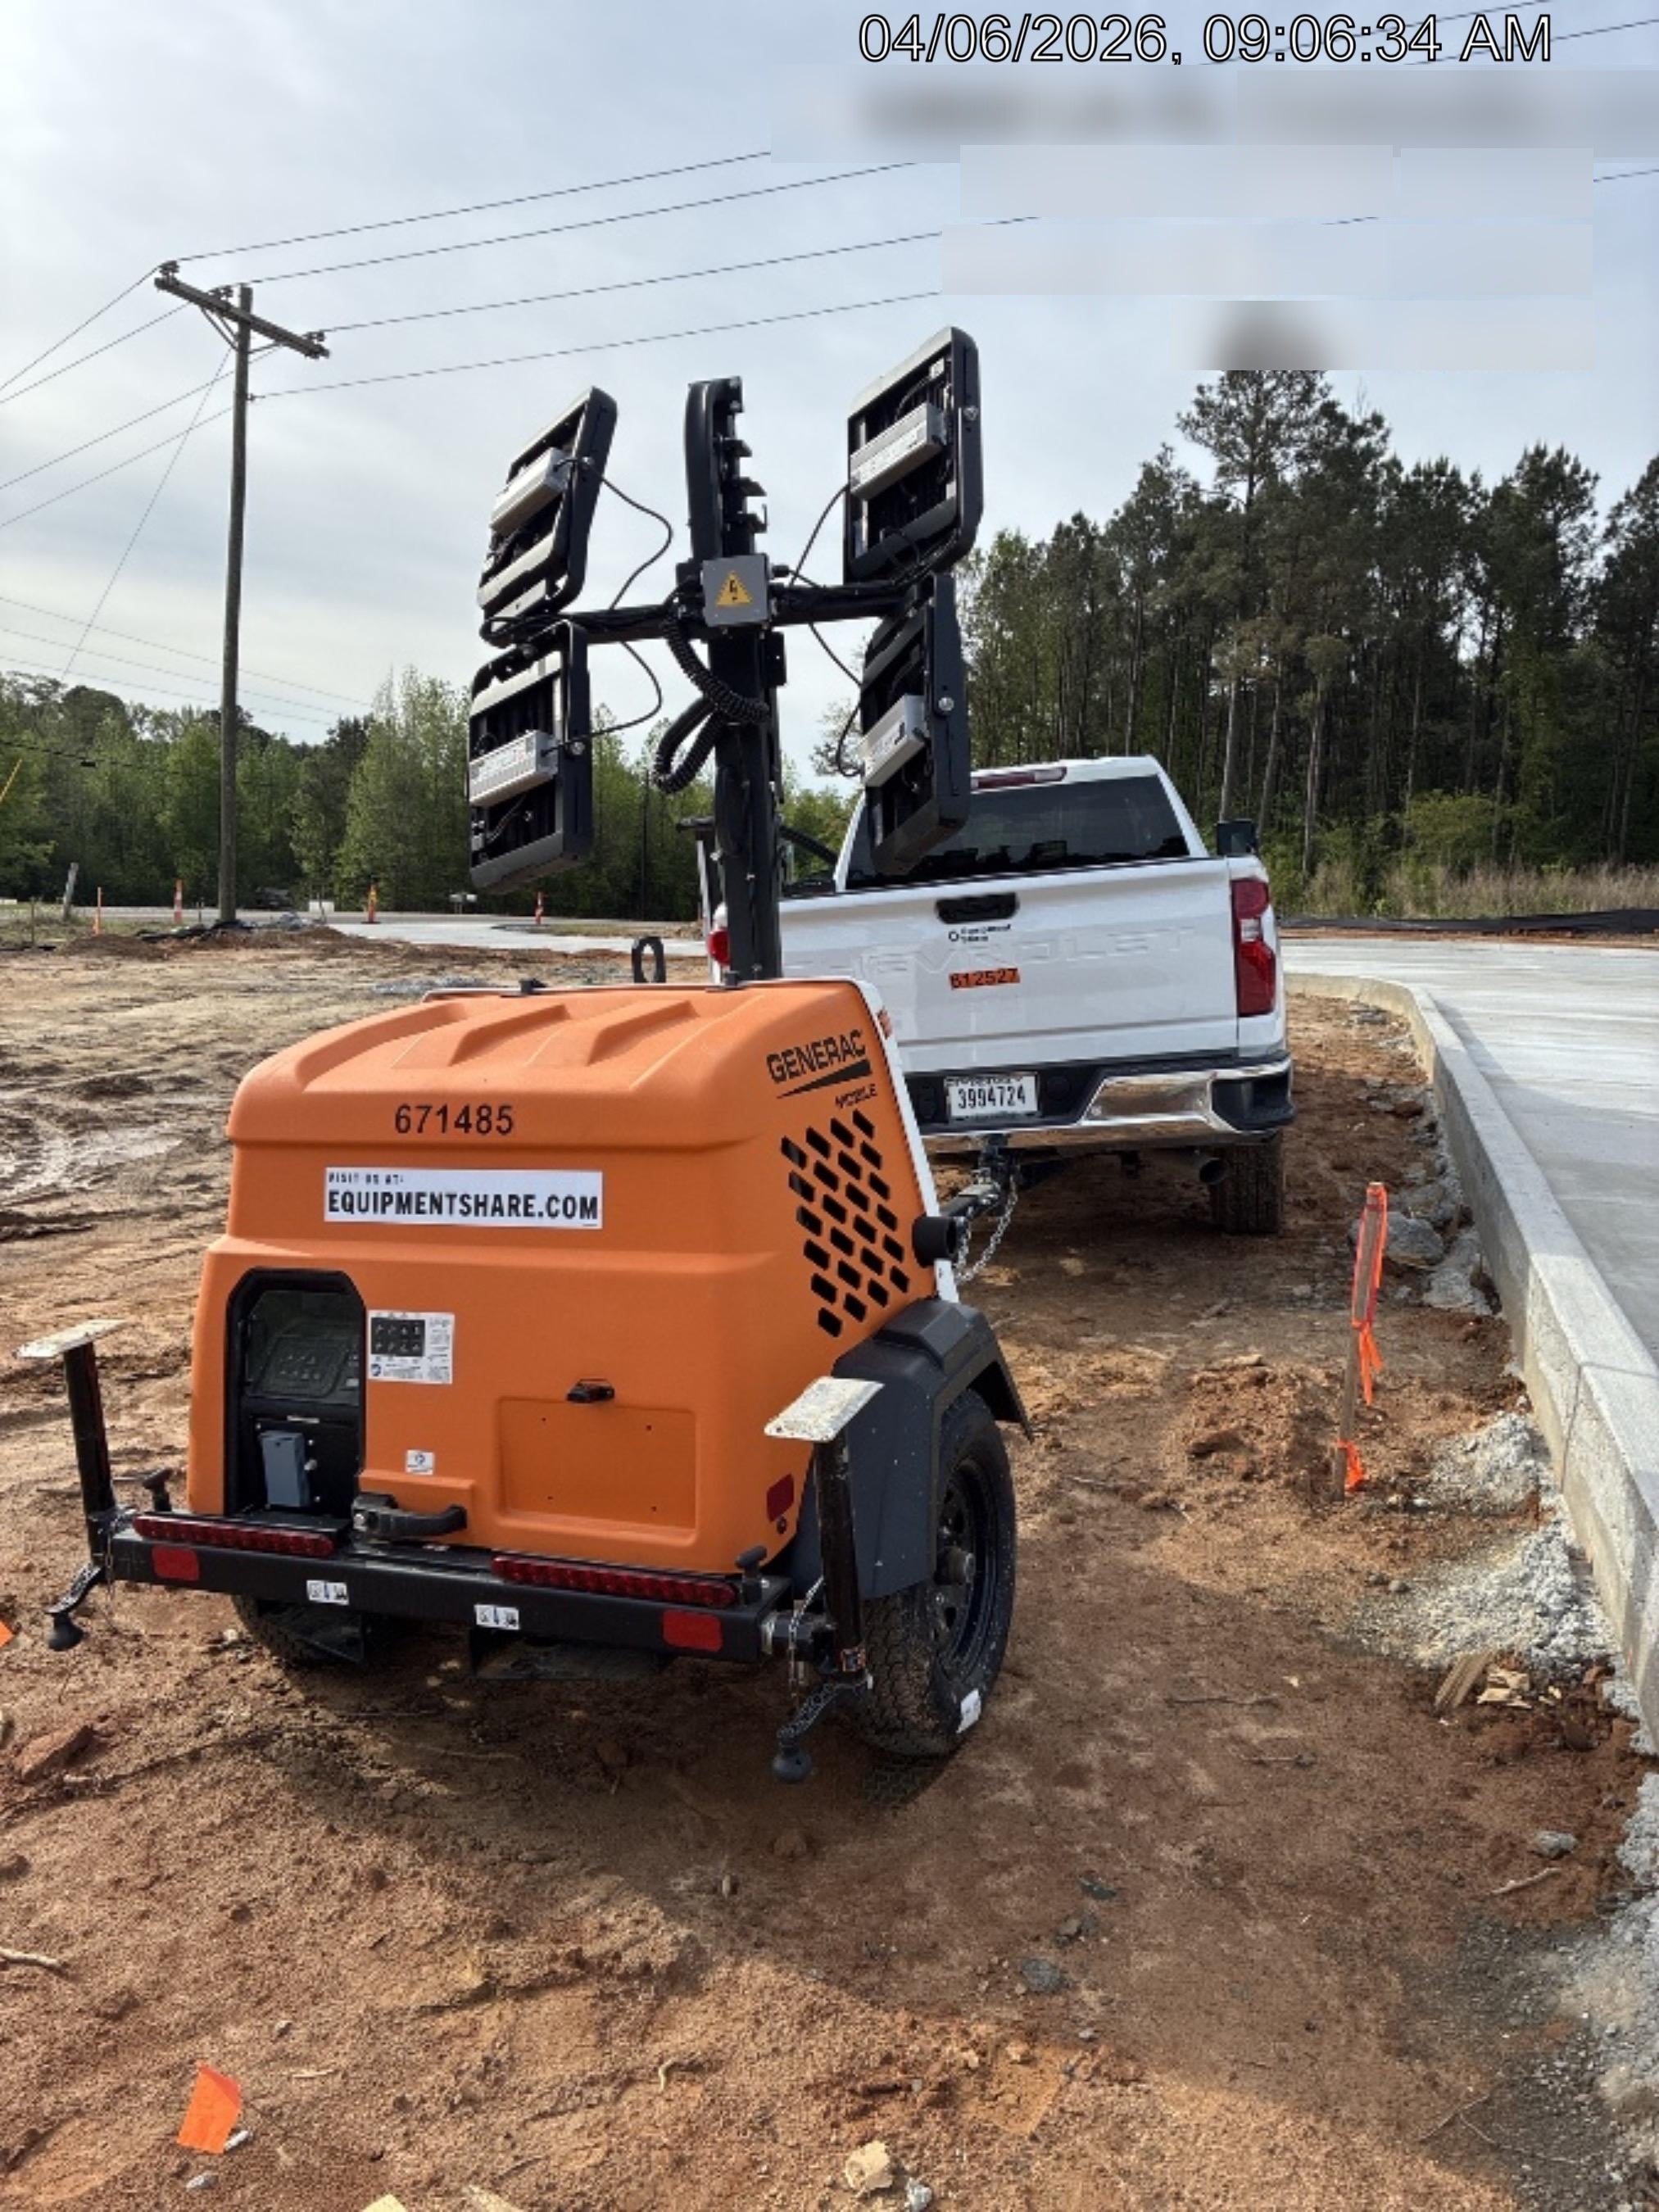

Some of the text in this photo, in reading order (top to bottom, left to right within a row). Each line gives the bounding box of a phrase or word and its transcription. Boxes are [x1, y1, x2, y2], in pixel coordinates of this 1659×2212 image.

[766, 1029, 867, 1084] GENERAC
[834, 1083, 878, 1108] MOBILE
[958, 1084, 1026, 1109] 3994724
[395, 1104, 514, 1135] 671485
[328, 1190, 598, 1221] EQUIPMENTSHARE.COM
